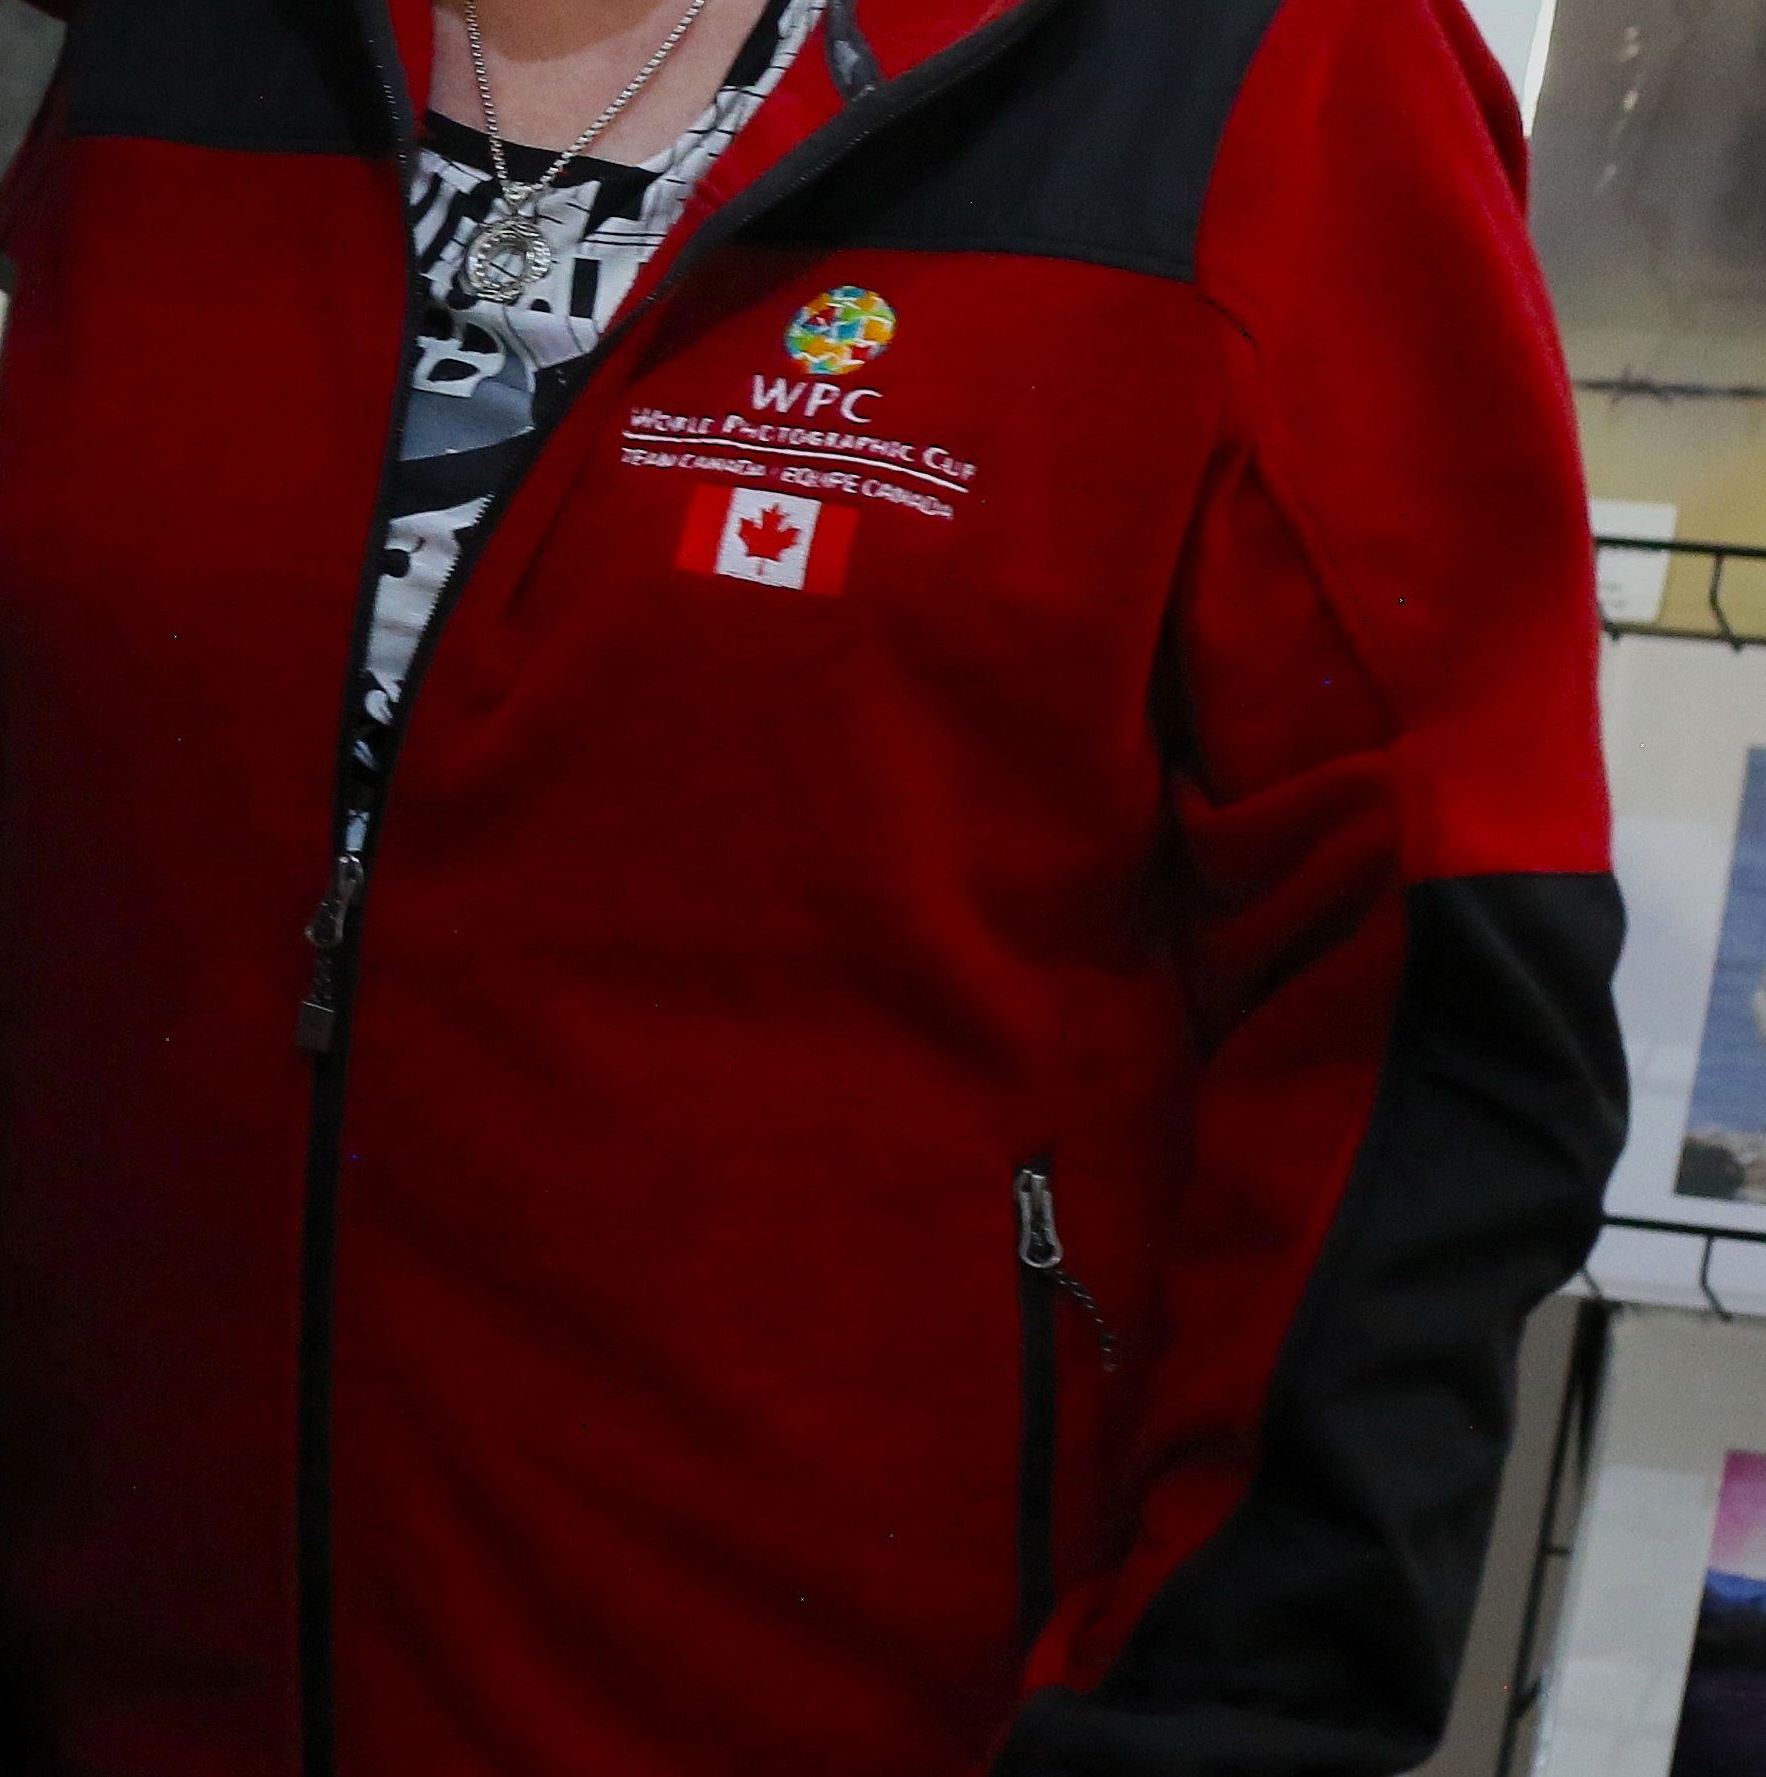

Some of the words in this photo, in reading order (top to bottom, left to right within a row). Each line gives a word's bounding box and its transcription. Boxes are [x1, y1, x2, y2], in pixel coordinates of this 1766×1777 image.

[751, 373, 883, 424] WPC
[721, 413, 916, 462] PHOTOGRAPHIC
[921, 446, 978, 480] CUP
[620, 447, 678, 469] TEAM
[677, 453, 766, 477] CANADA
[861, 478, 954, 520] CANADA
